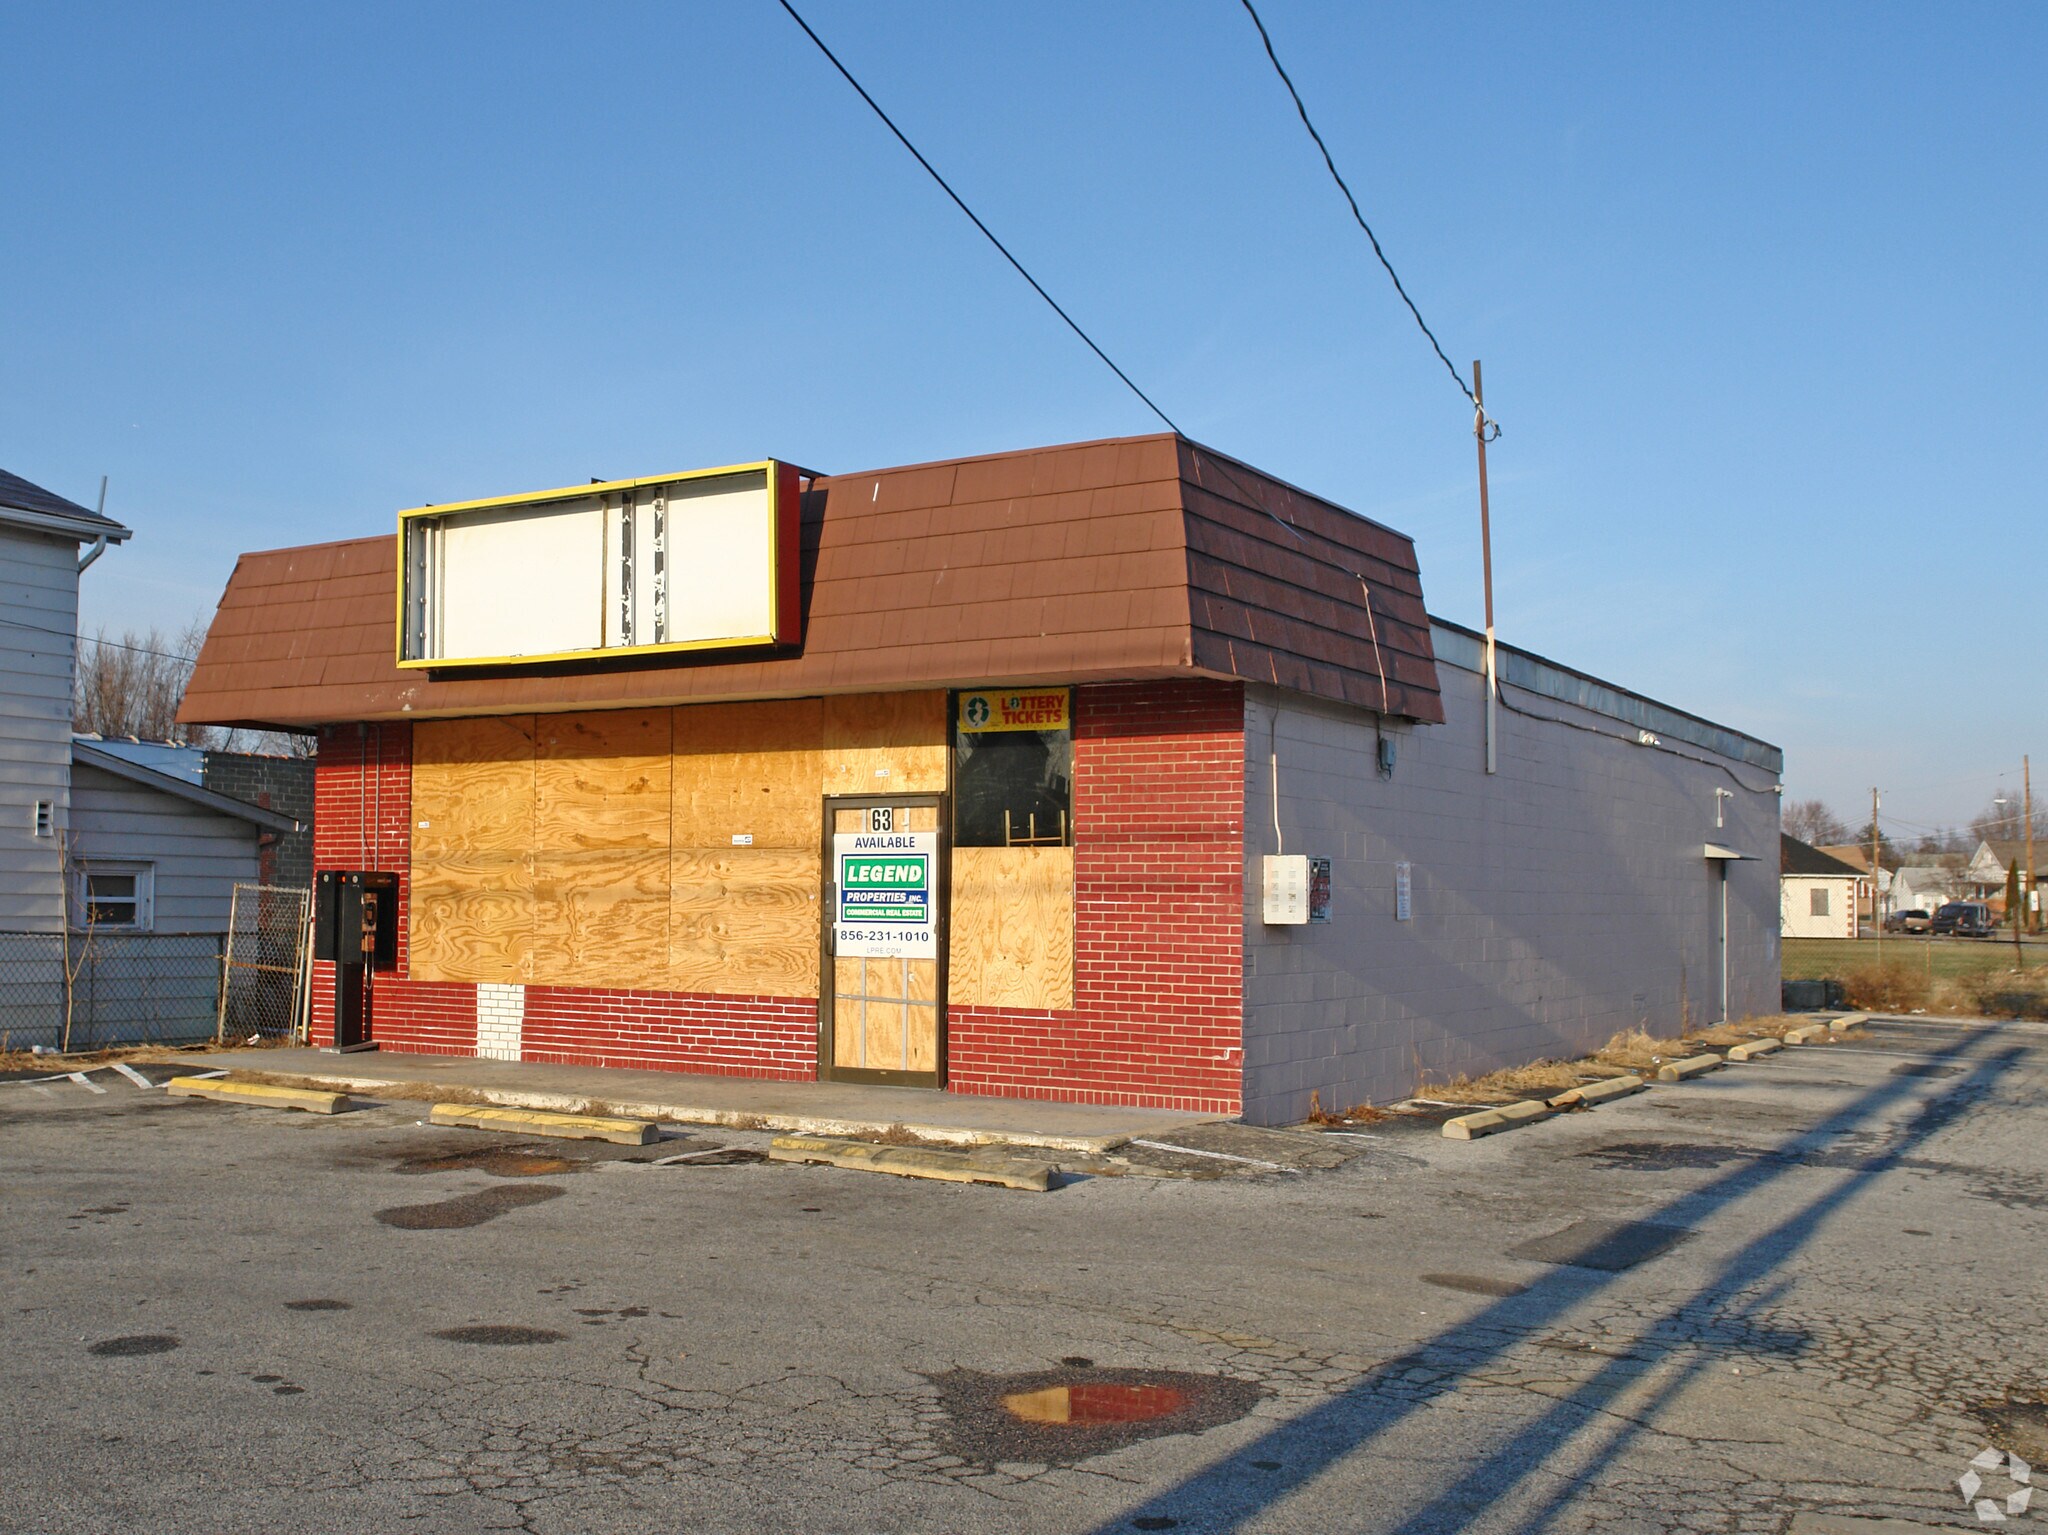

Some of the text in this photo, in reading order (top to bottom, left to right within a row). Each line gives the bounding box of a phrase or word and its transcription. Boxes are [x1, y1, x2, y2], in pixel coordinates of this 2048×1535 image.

[1001, 695, 1065, 711] LOTTERY
[1002, 709, 1062, 725] TICKETS
[872, 809, 891, 831] 63
[855, 836, 915, 848] AVAILABLE
[847, 865, 923, 882] LEGEND
[846, 892, 923, 903] PROPERTIES INC.
[846, 908, 923, 917] COMMERCIAL REAL ESTATE
[840, 930, 929, 942] 856-231-1010
